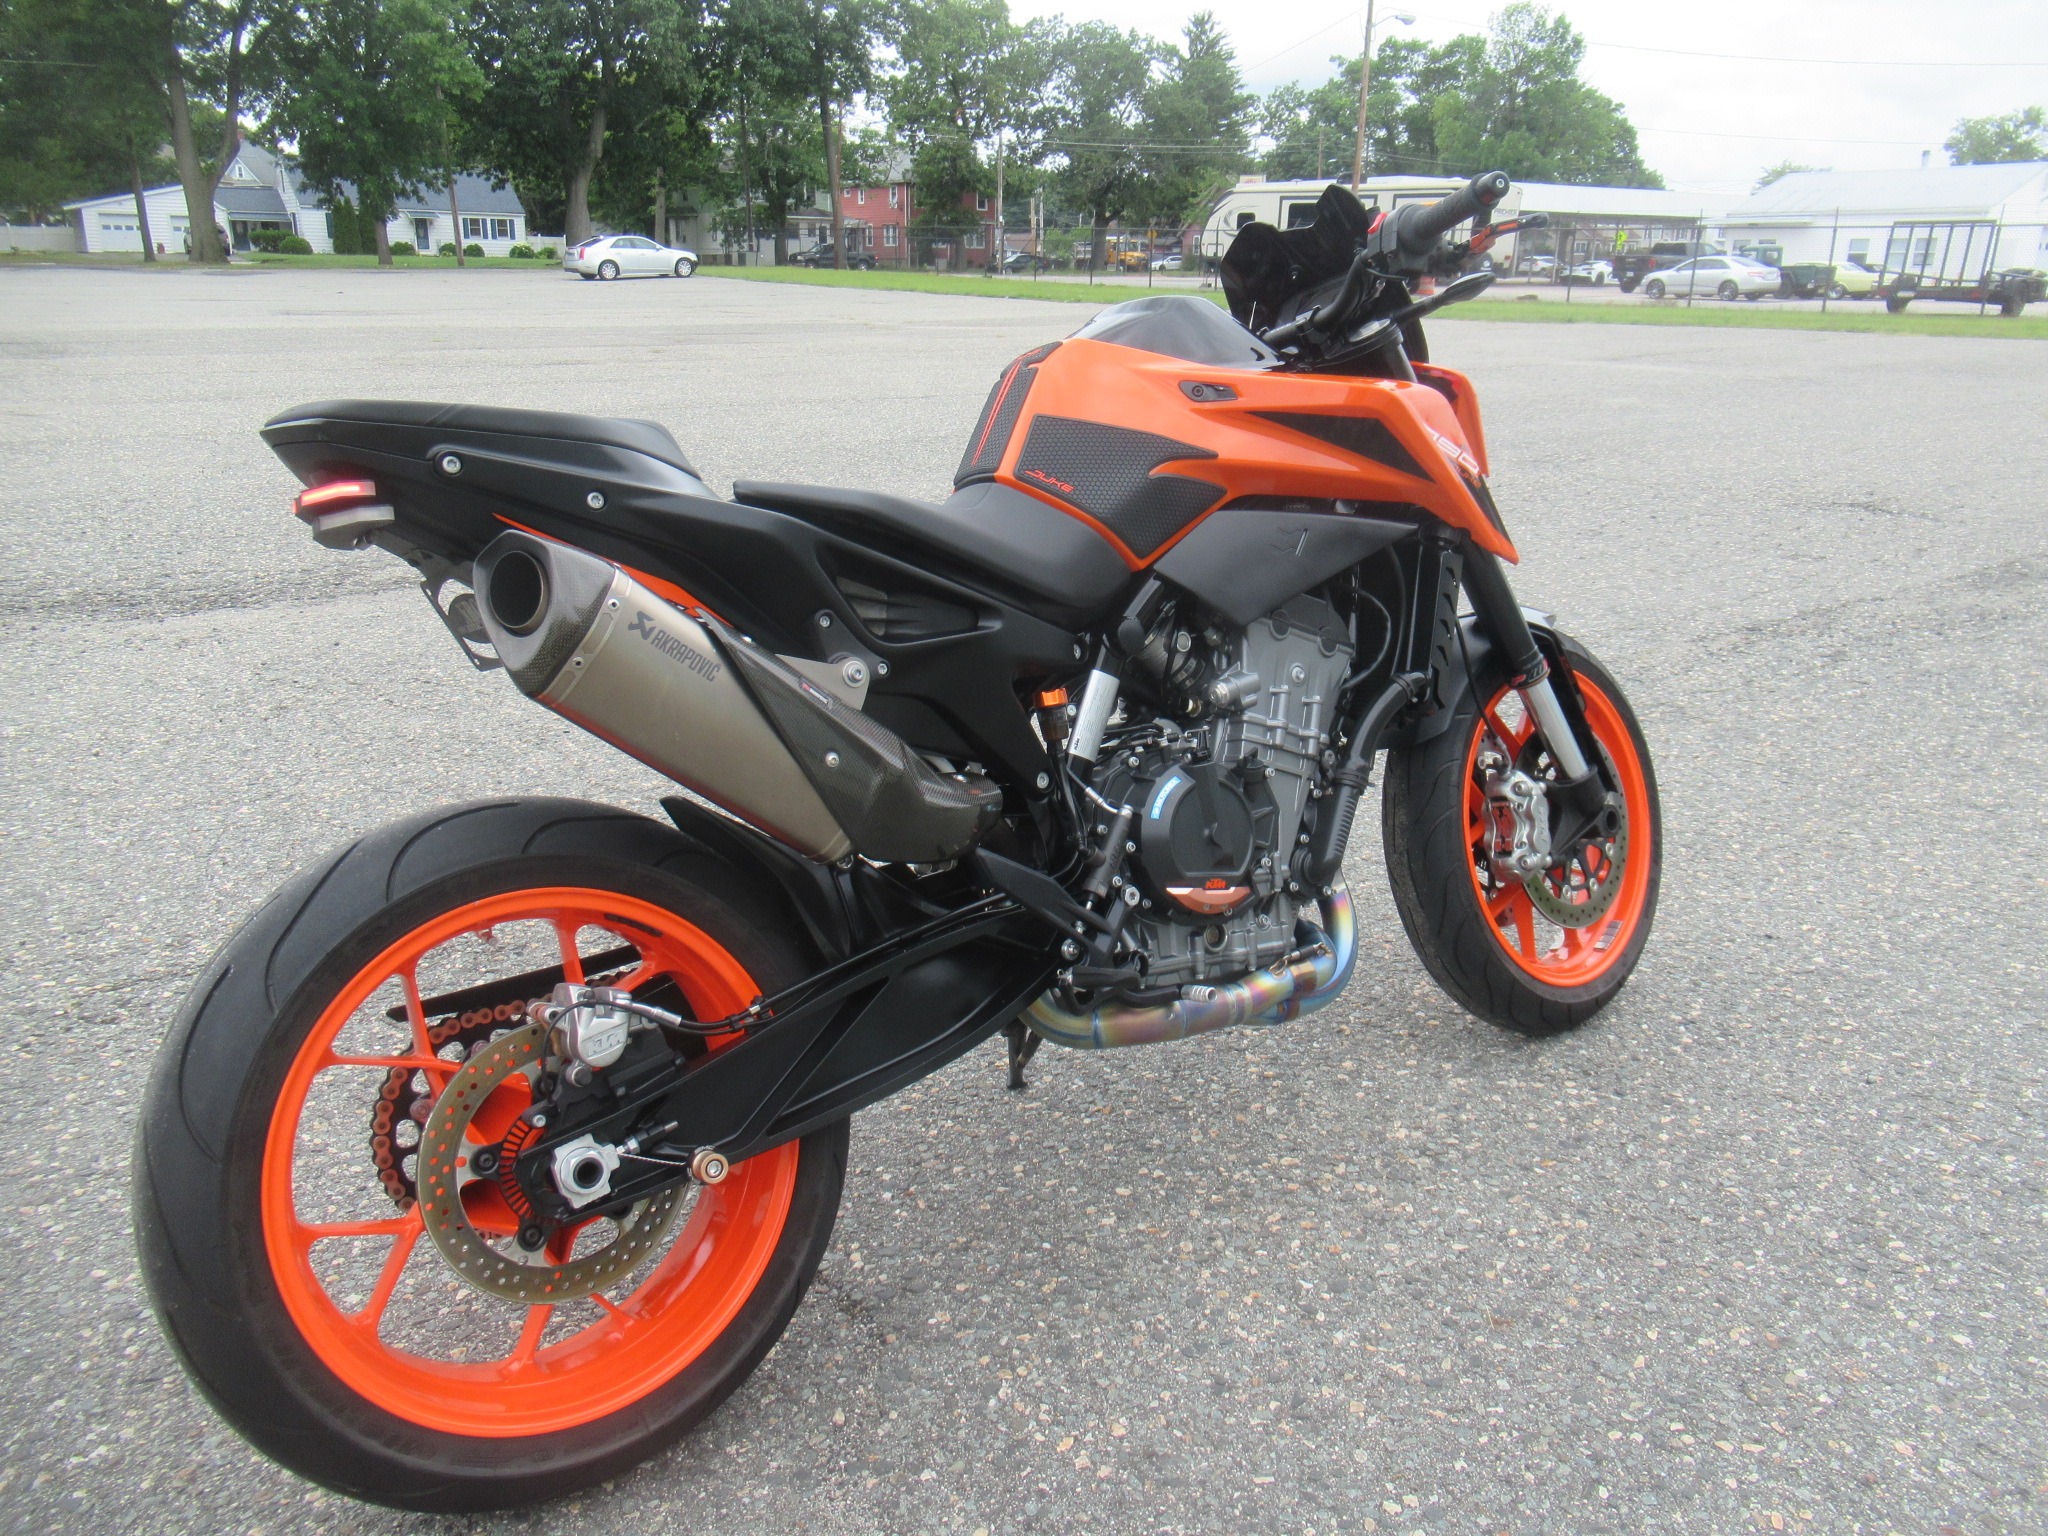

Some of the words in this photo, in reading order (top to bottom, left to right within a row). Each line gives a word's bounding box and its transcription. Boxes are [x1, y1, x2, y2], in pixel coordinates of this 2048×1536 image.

[1422, 422, 1480, 475] 790
[1024, 469, 1075, 493] DUKE
[1204, 878, 1227, 889] KTM
[587, 1028, 627, 1057] KTM
